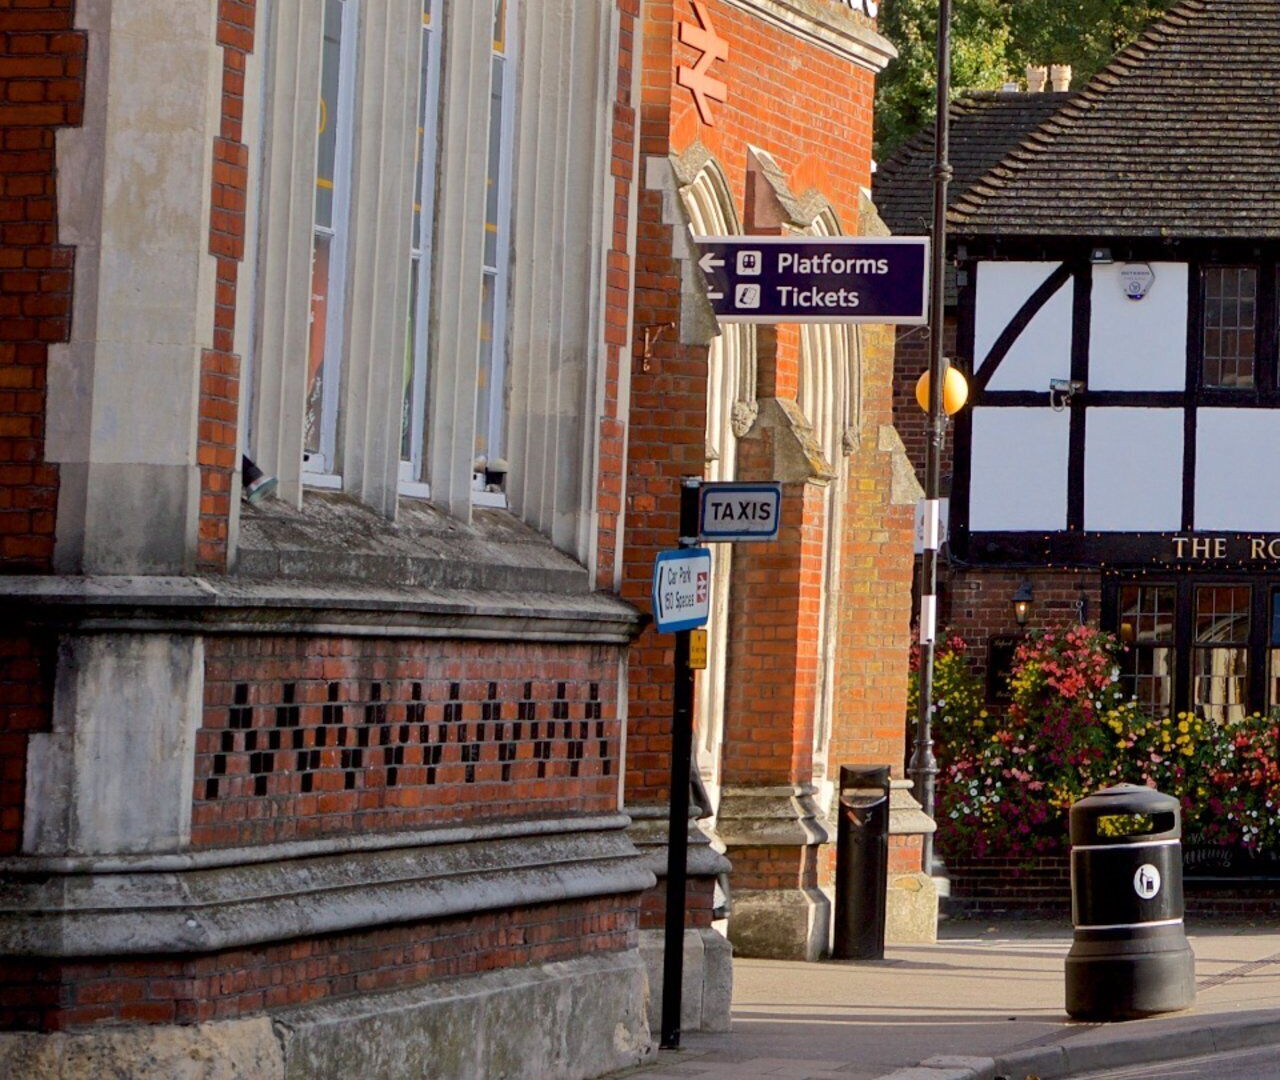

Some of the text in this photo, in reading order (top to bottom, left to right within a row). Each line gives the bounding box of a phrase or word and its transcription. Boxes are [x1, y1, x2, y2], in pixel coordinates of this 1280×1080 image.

[778, 253, 889, 275] Platforms
[776, 286, 860, 308] Tickets
[711, 501, 771, 521] TAXIS
[1172, 537, 1228, 559] THE
[667, 566, 692, 586] Car Park
[675, 591, 695, 611] Spaces
